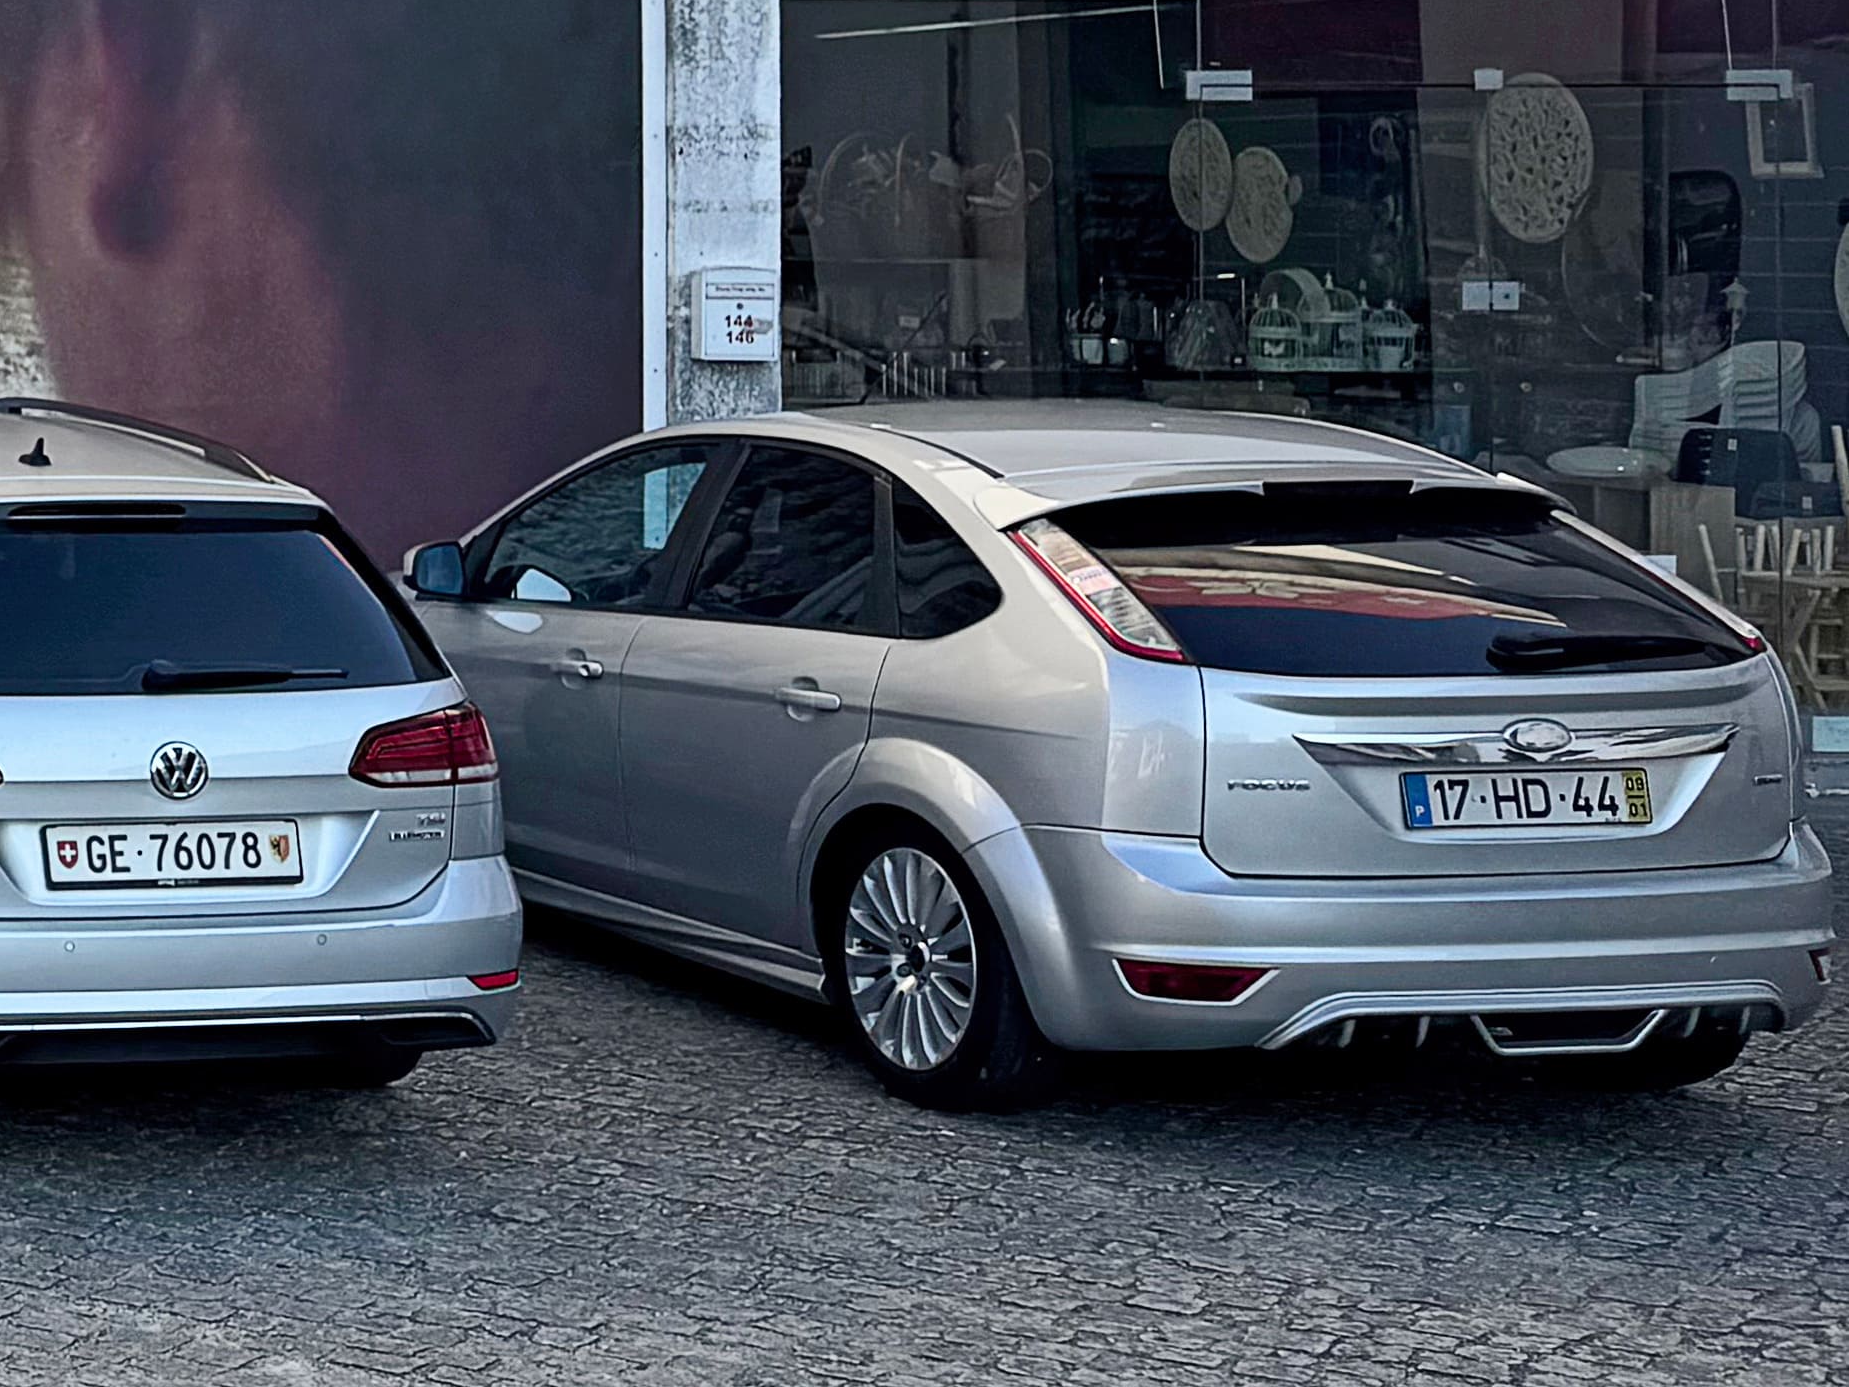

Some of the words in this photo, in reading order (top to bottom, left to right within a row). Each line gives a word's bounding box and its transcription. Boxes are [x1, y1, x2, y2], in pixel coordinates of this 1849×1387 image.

[725, 315, 754, 328] 144
[1227, 779, 1311, 792] FOCUS
[1415, 805, 1426, 818] P
[1629, 802, 1647, 817] 01
